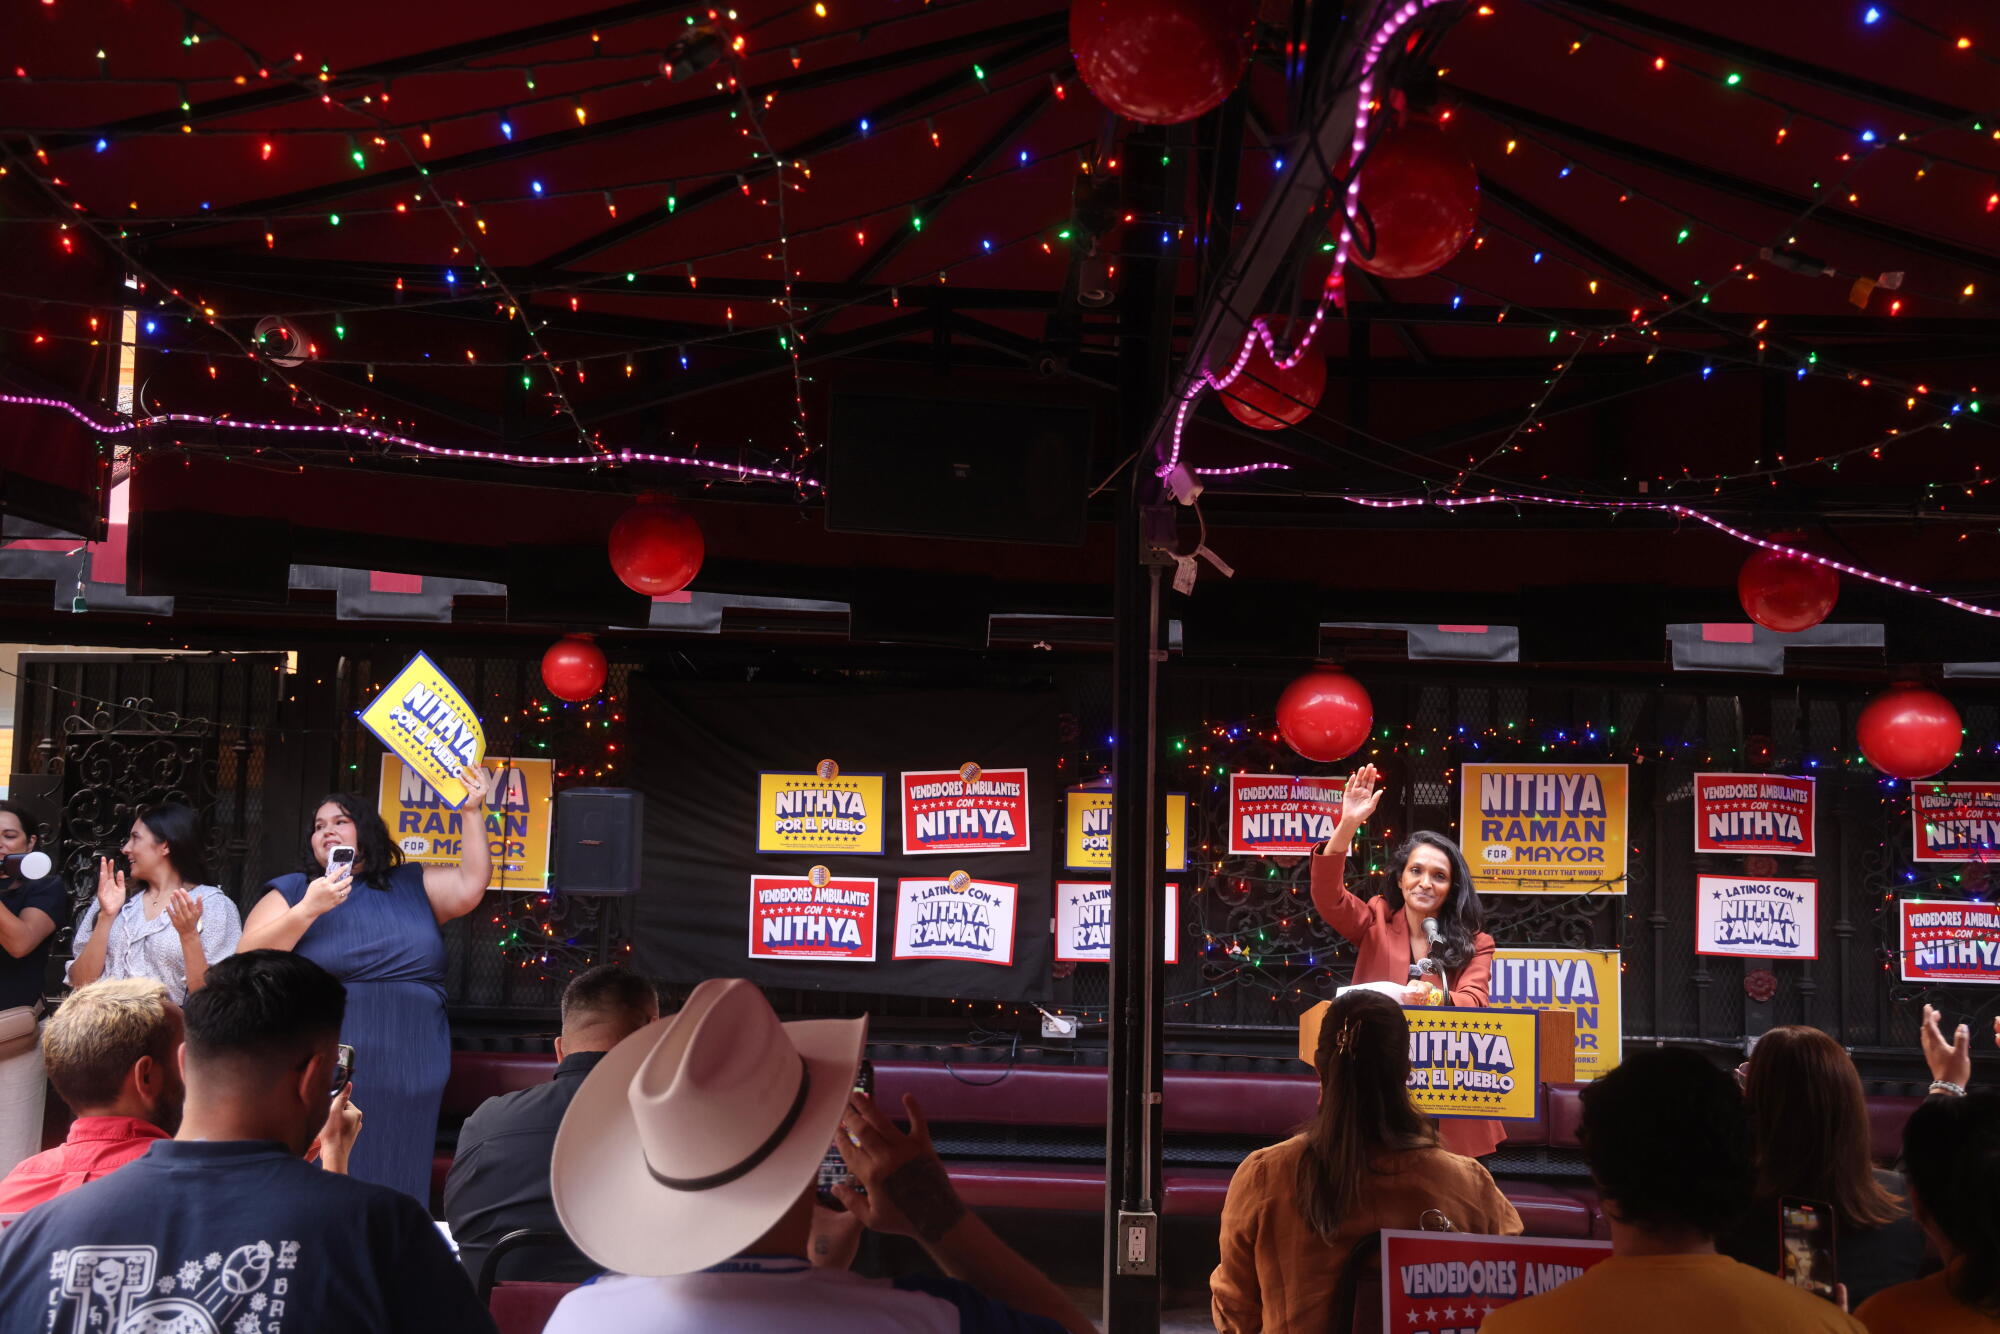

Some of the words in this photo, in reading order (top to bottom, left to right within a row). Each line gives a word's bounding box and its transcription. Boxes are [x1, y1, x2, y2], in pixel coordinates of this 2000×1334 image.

[402, 682, 478, 768] NITHYA
[389, 706, 418, 735] POR
[412, 725, 430, 746] EL
[424, 736, 464, 779] PUEBLO
[910, 782, 963, 801] VENDEDORES
[965, 781, 1020, 799] AMBULANTES
[1238, 786, 1288, 802] VENDEDORES
[1290, 785, 1343, 803] AMBULANTES
[1480, 773, 1607, 818] NITHYA
[1703, 783, 1758, 801] VENDEDORES
[1759, 784, 1809, 804] AMBULANTES
[775, 790, 867, 820] NITHYA
[956, 798, 975, 808] CON
[1280, 803, 1299, 811] CON
[1750, 801, 1769, 810] CON
[398, 810, 528, 837] RAAN
[1966, 810, 1984, 818] CON
[775, 819, 802, 834] POR
[804, 819, 818, 833] EL
[820, 819, 866, 835] PUEBLO
[916, 808, 1016, 843] NITHYA
[1241, 812, 1336, 844] NITHYA
[1480, 820, 1606, 842] RAMAN
[1708, 811, 1804, 844] NITHYA
[404, 841, 424, 851] FOR
[432, 838, 526, 858] MAOR
[1082, 836, 1109, 851] POR
[1487, 849, 1507, 859] FOR
[1515, 846, 1605, 862] MAYOR
[1482, 868, 1500, 876] VOTE
[1501, 868, 1515, 876] NOV.
[1517, 868, 1522, 876] 3
[1523, 868, 1537, 876] FOR
[1543, 868, 1558, 876] CITY
[1560, 868, 1574, 876] THAT
[1575, 868, 1604, 877] WORKS!
[758, 888, 812, 907] VENDEDORES
[814, 887, 870, 907] AMBULANTES
[922, 886, 965, 900] LATIN
[968, 888, 992, 903] CON
[1725, 884, 1771, 898] LATINOS
[1773, 887, 1795, 901] CON
[804, 906, 823, 915] CON
[917, 901, 989, 927] NITHYA
[1720, 900, 1796, 924] NITHYA
[1909, 911, 1962, 928] VENDEDORES
[762, 915, 863, 950] NITHYA
[909, 922, 996, 951] RAMAN
[1713, 920, 1801, 949] RAMAN
[1955, 929, 1973, 938] CON
[1405, 1070, 1430, 1090] OR
[1432, 1069, 1449, 1090] EL
[1453, 1069, 1515, 1095] PUEBLO
[1400, 1260, 1518, 1298] VENDEDORES
